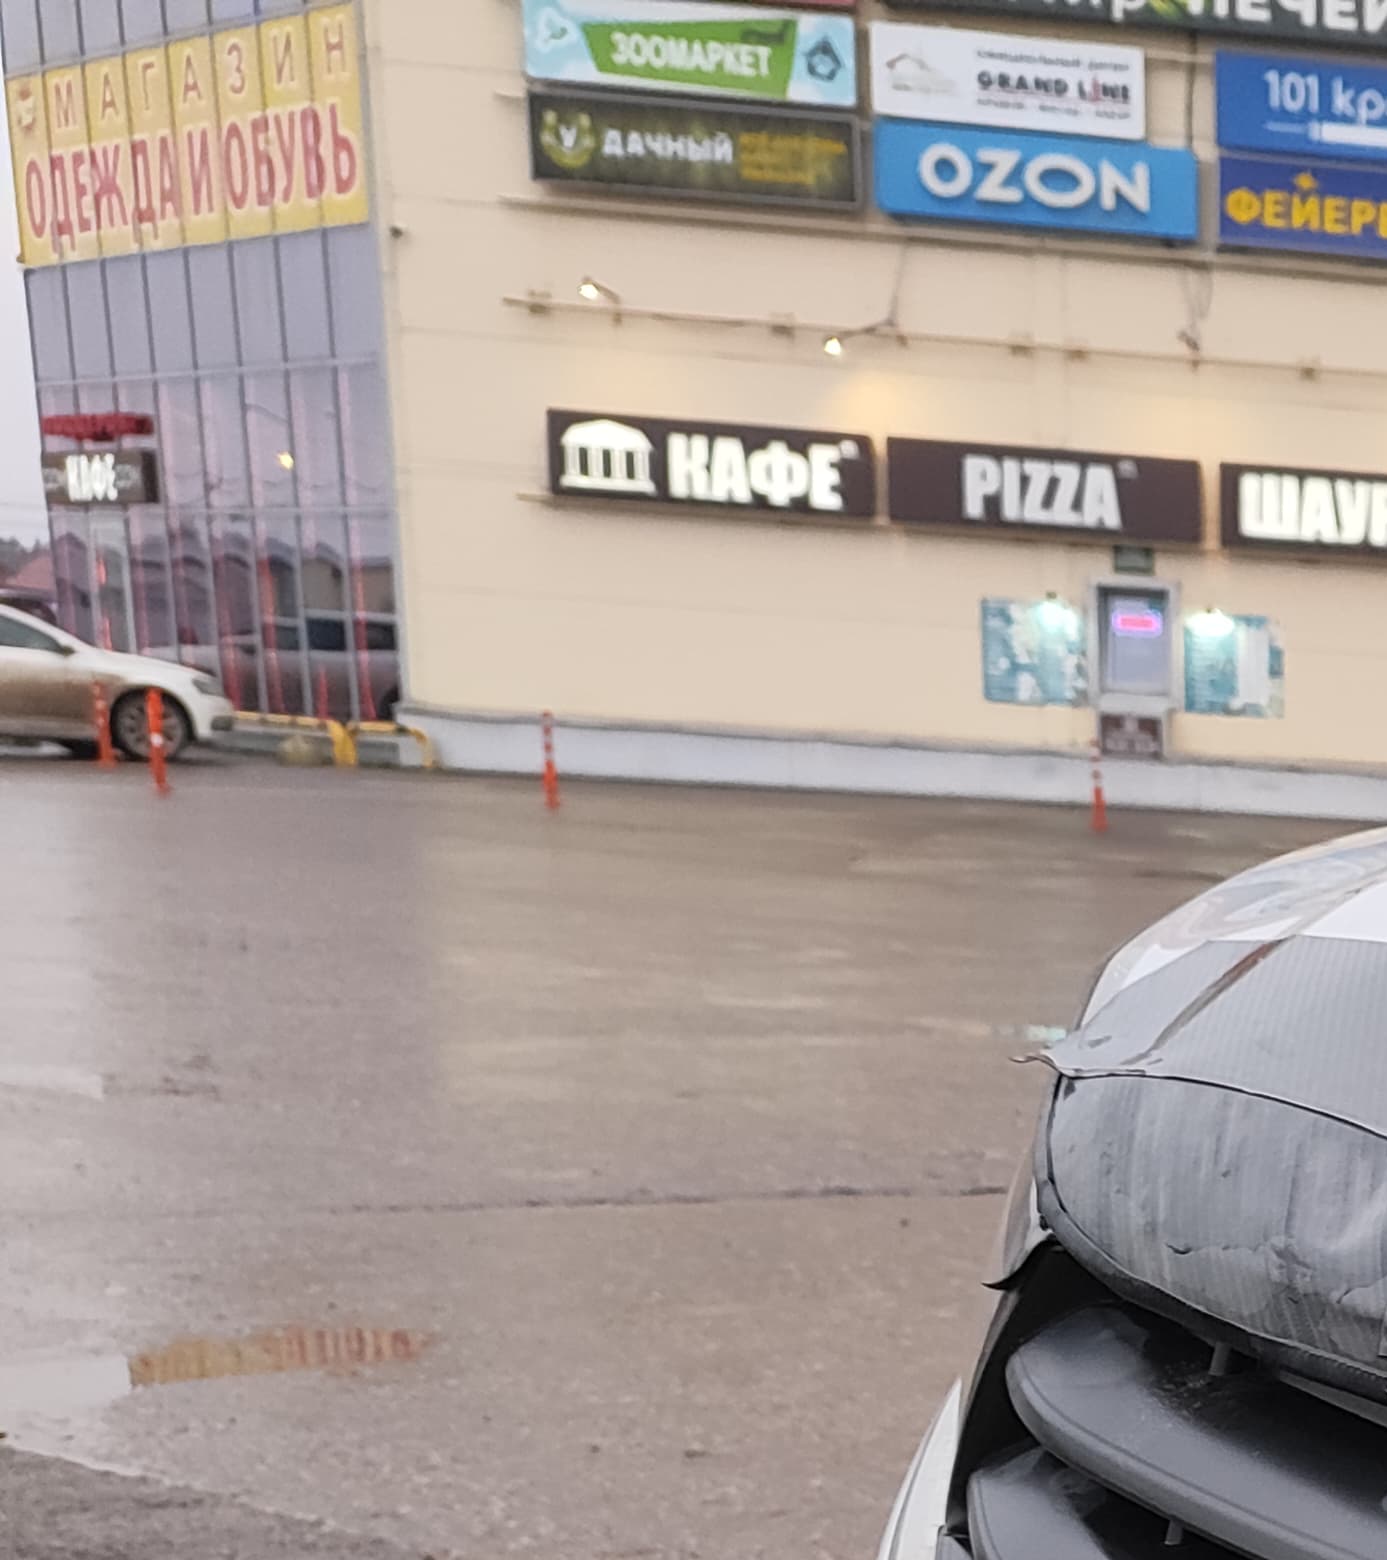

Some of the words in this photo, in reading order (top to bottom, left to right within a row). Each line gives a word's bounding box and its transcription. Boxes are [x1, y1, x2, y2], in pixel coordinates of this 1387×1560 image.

[54, 13, 346, 129] МАГАЗИН
[610, 31, 772, 78] ЗООМАРКЕТ
[977, 70, 1069, 98] GRAND
[1264, 69, 1320, 114] 101
[25, 134, 183, 254] ОДЕЖДА
[187, 128, 214, 215] И
[223, 103, 357, 210] ОБУВЬ
[603, 129, 733, 164] ДАЧНЫЙ
[918, 142, 1150, 214] OZON
[666, 433, 845, 512] КАФЕ
[962, 454, 1122, 530] PIZZA
